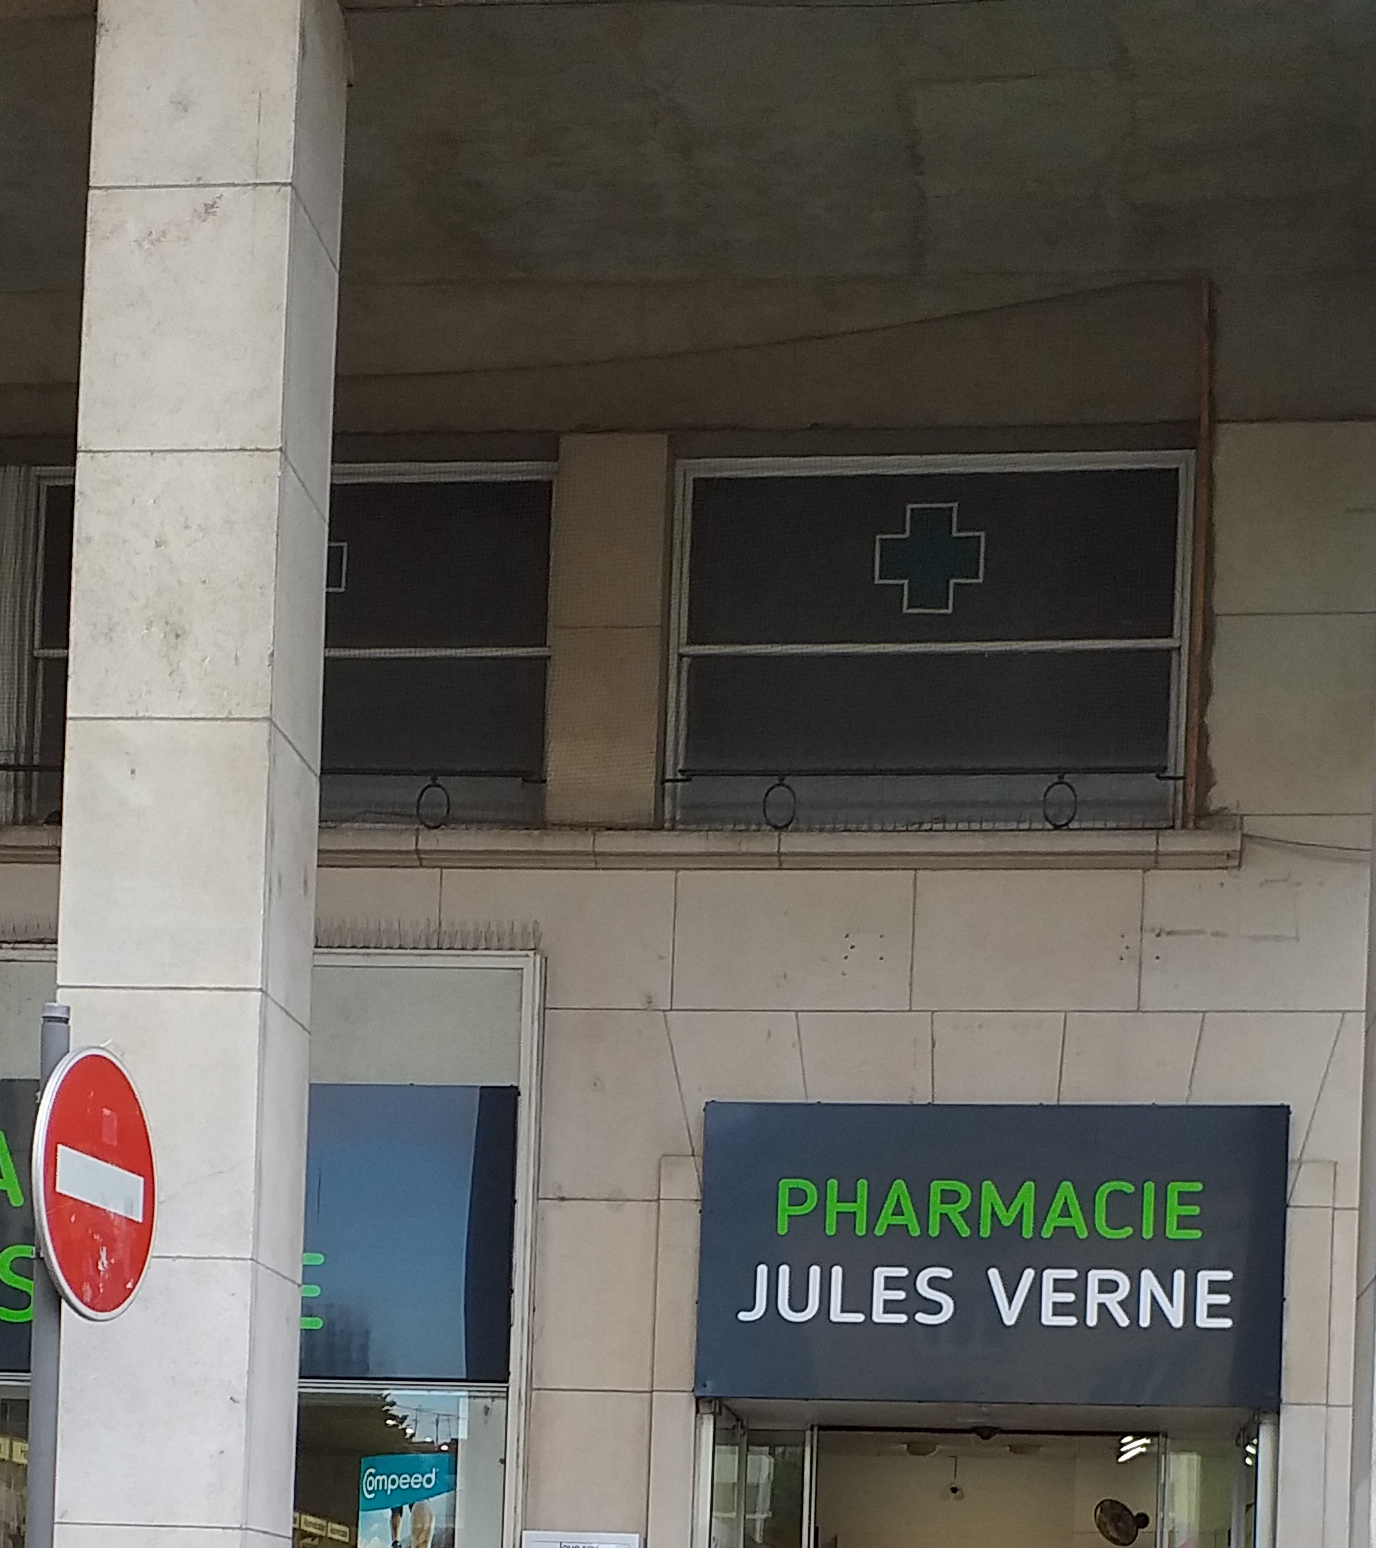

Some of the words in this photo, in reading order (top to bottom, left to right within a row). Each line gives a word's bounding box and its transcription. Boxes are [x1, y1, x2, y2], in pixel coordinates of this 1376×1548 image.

[776, 1178, 1204, 1240] PHARMACIE
[737, 1263, 955, 1325] JULES
[987, 1267, 1234, 1329] VERNE
[363, 1468, 437, 1499] Compeed
